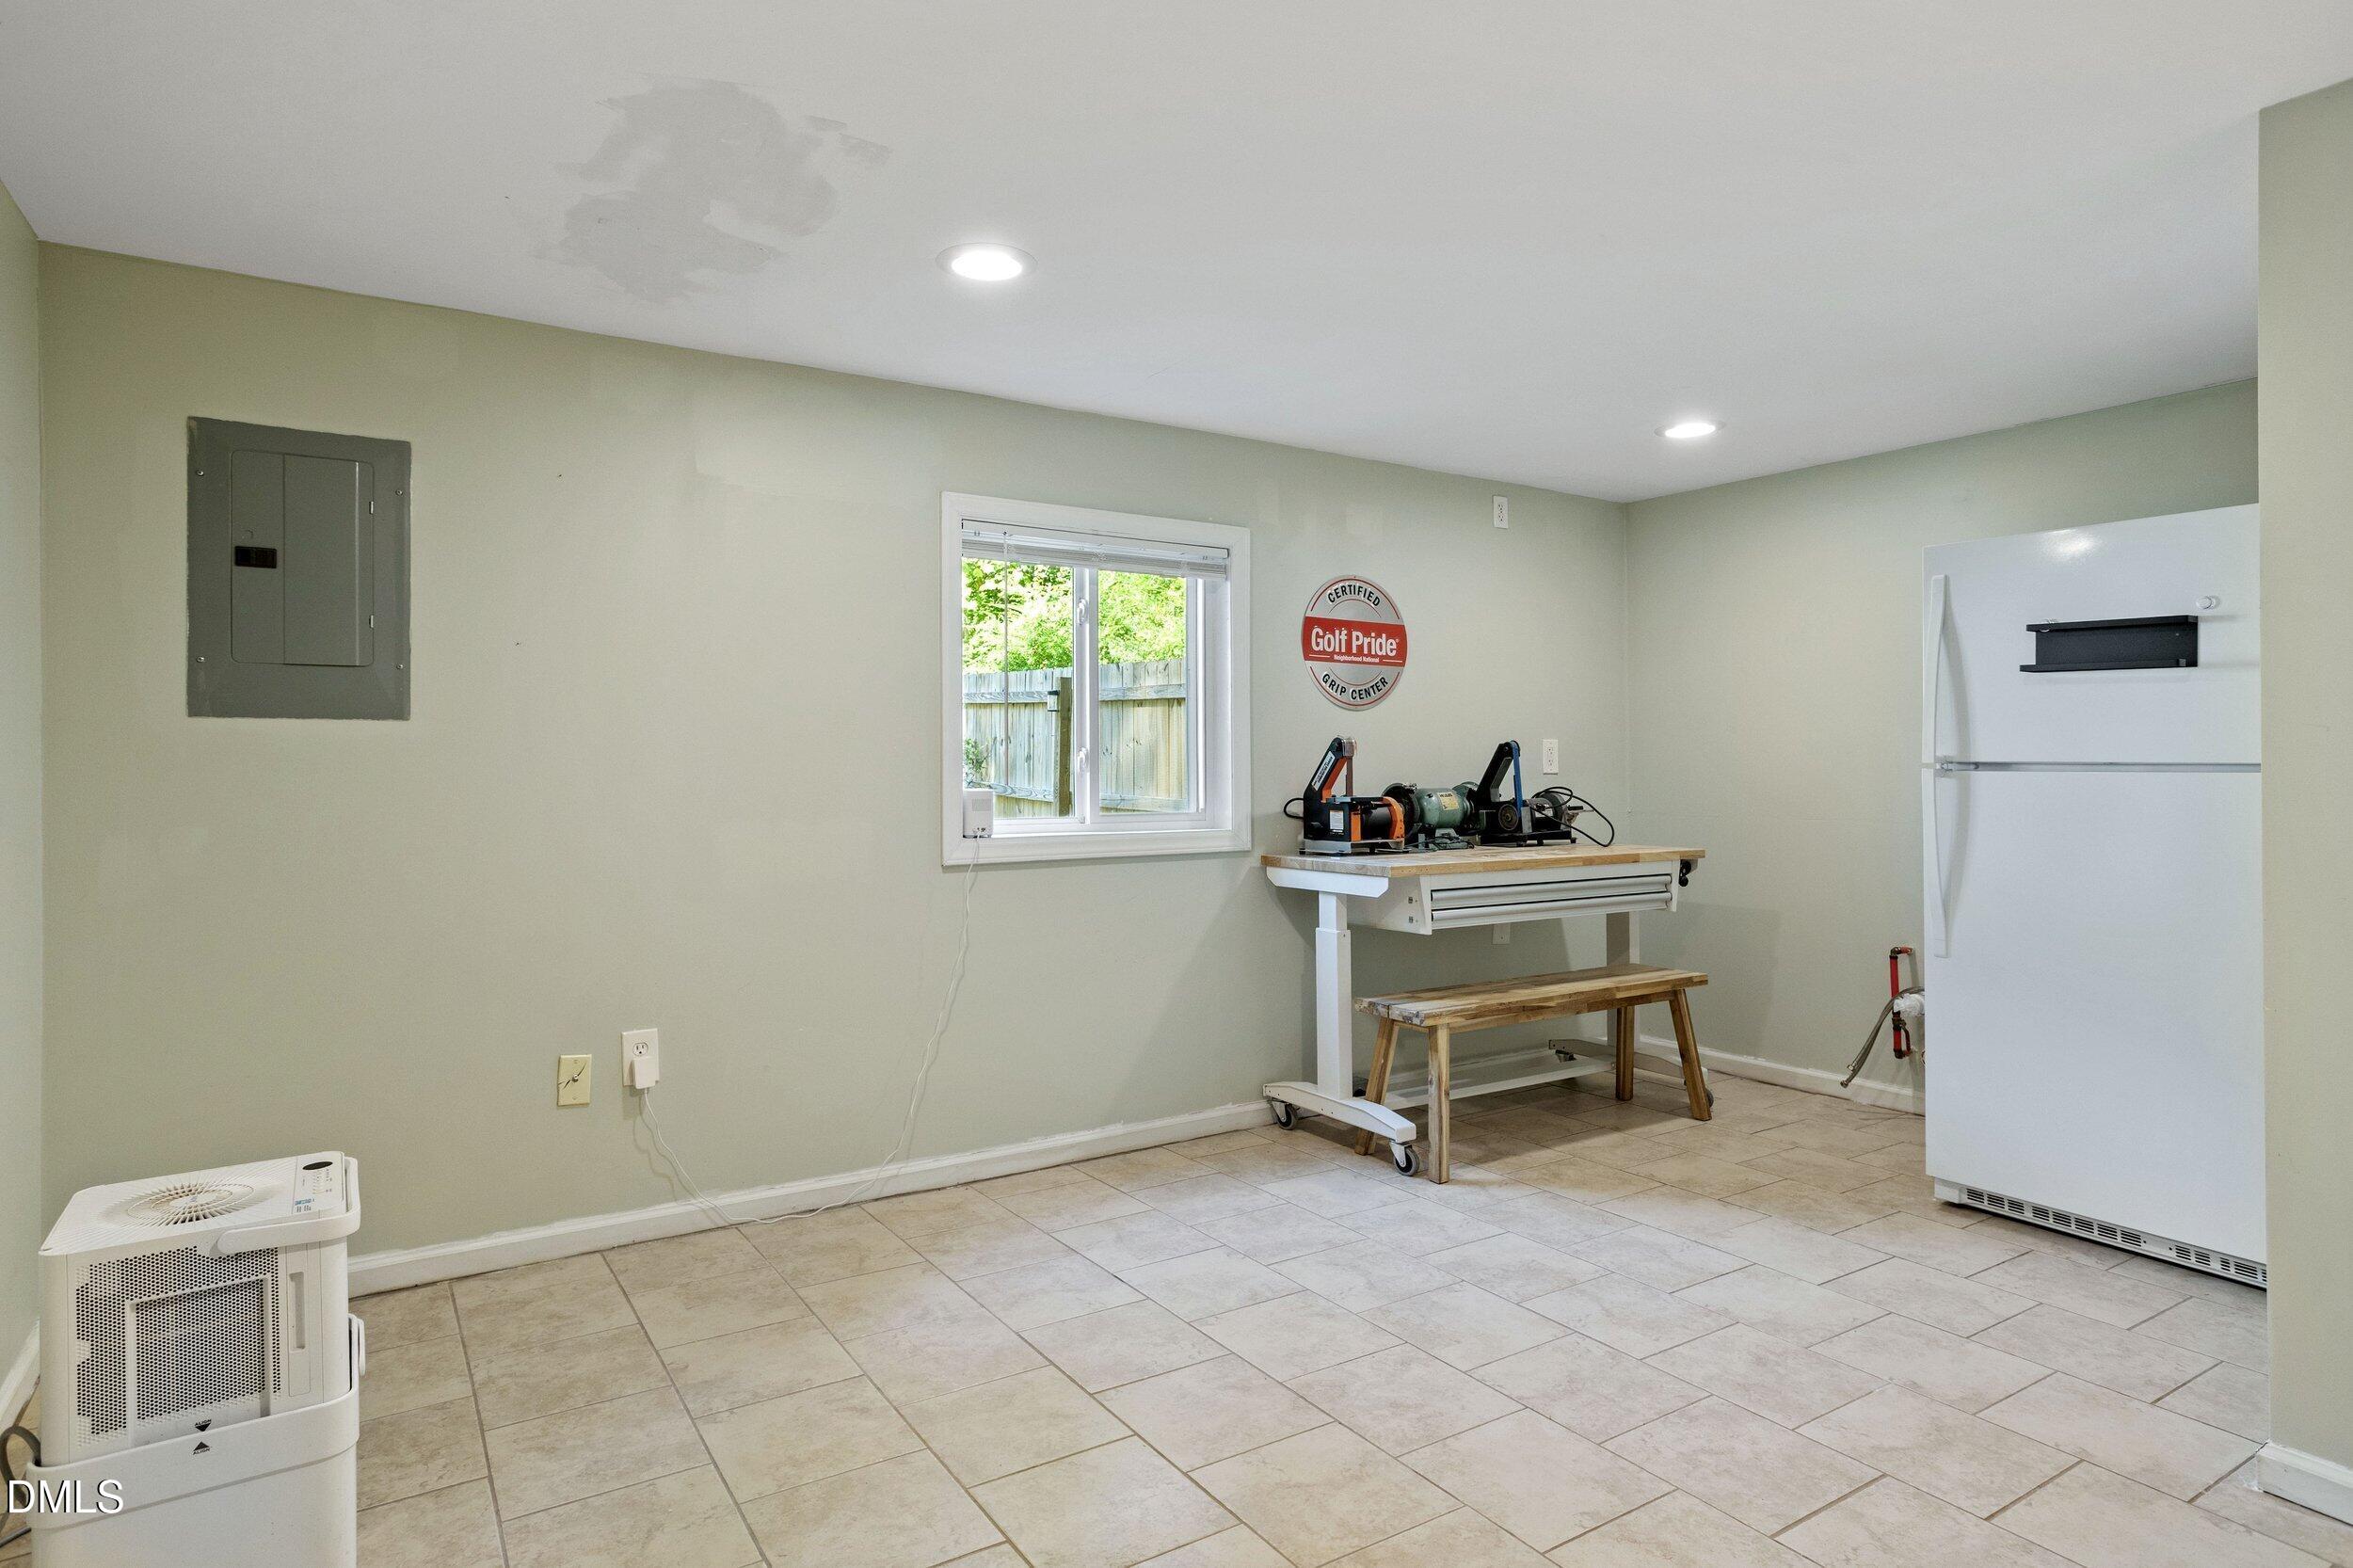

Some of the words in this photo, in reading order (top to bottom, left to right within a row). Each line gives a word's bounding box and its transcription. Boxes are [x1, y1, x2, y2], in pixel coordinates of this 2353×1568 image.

[1327, 584, 1381, 607] CERTIFIED
[1311, 627, 1347, 653] Golf
[1321, 673, 1347, 696] GRIP
[1351, 677, 1388, 700] CENTER
